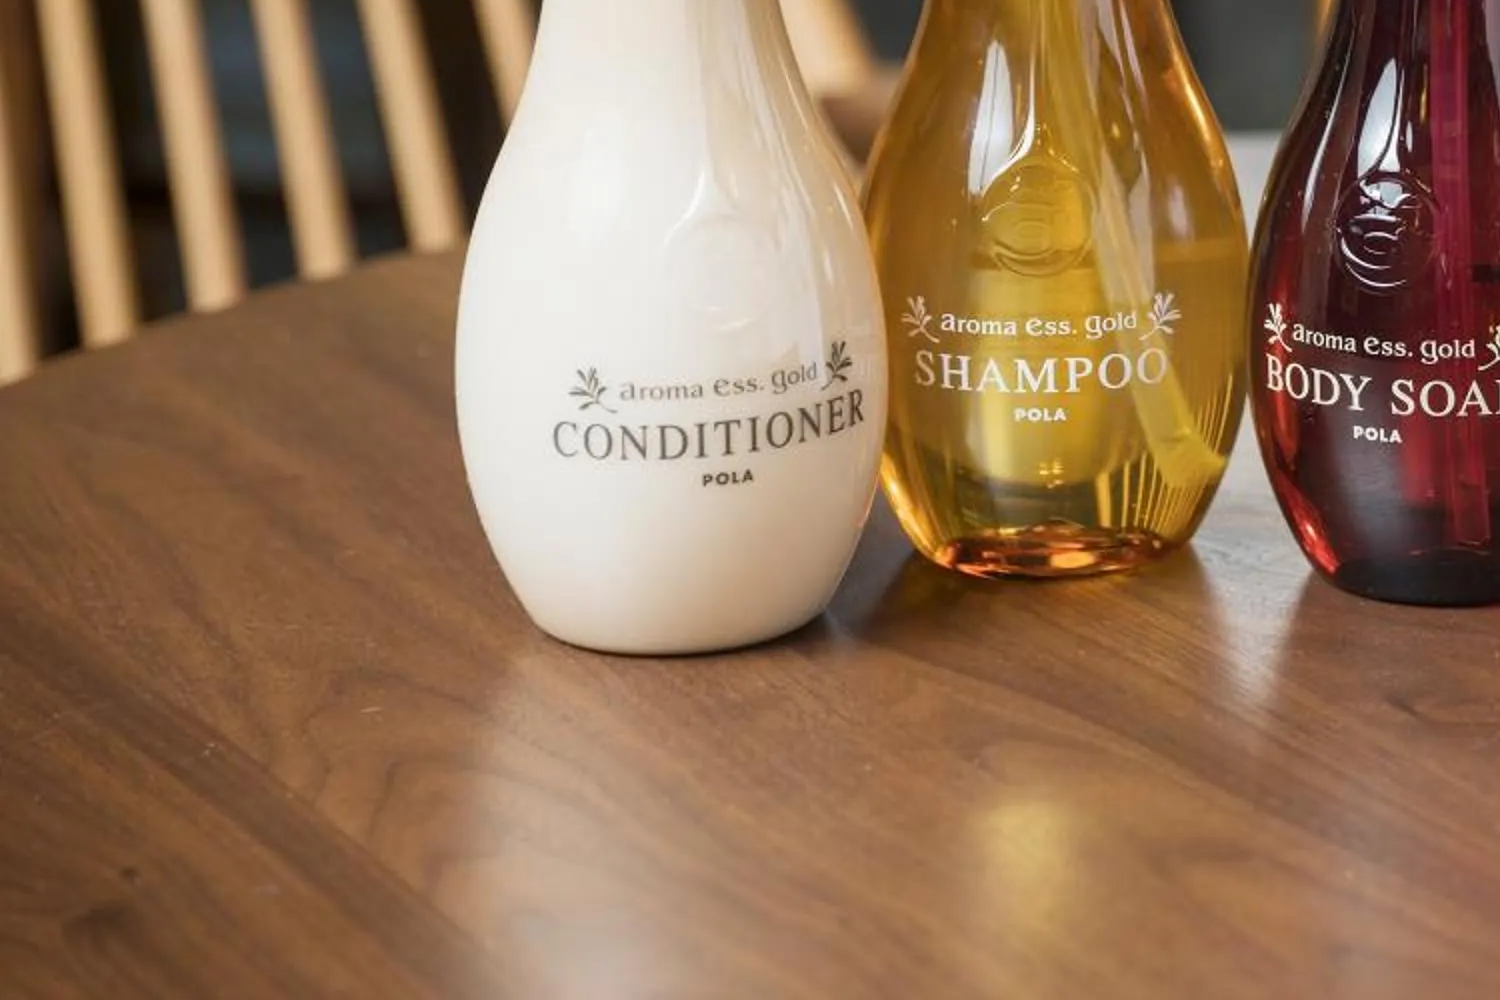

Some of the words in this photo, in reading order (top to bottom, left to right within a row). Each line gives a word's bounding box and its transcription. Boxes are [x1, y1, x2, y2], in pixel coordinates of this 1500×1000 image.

[941, 313, 1017, 335] aroma
[1025, 318, 1077, 337] ess.
[1085, 311, 1137, 339] gold
[1293, 323, 1357, 353] aroma
[1363, 336, 1412, 357] ess.
[1420, 339, 1475, 364] gold
[619, 382, 703, 400] aroma
[713, 376, 764, 397] ess.
[771, 361, 817, 394] gold
[915, 348, 1168, 393] SHAMPOO
[1265, 353, 1372, 411] BODY
[552, 389, 865, 461] CONDITIONER
[1015, 408, 1067, 421] POLA
[1353, 426, 1402, 443] POLA
[702, 469, 754, 486] POLA
